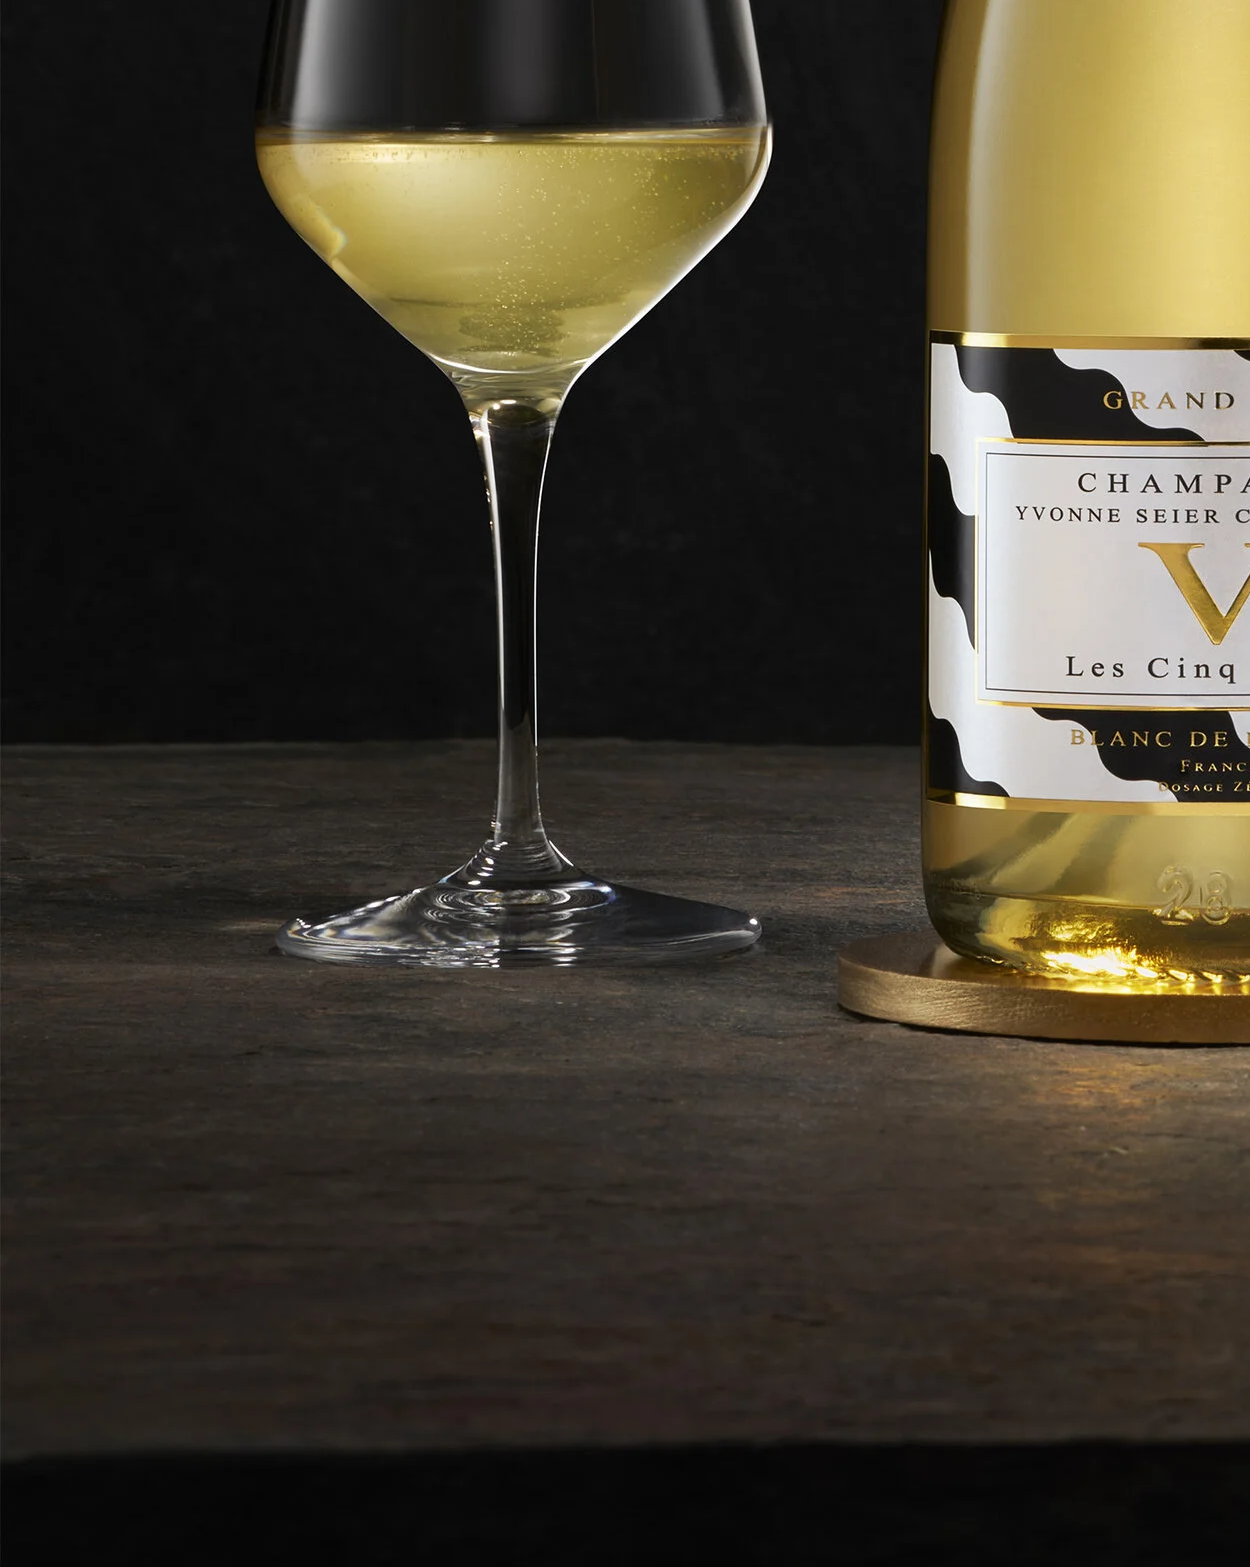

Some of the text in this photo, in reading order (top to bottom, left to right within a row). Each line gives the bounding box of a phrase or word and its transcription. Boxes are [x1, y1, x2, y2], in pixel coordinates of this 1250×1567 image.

[1102, 390, 1236, 411] GRAND
[1015, 504, 1122, 524] YVONNE
[1135, 507, 1221, 524] SEIER
[1065, 655, 1126, 679] Les
[1147, 657, 1238, 685] Cinq
[1070, 728, 1173, 748] BLANC
[1189, 730, 1229, 748] DE
